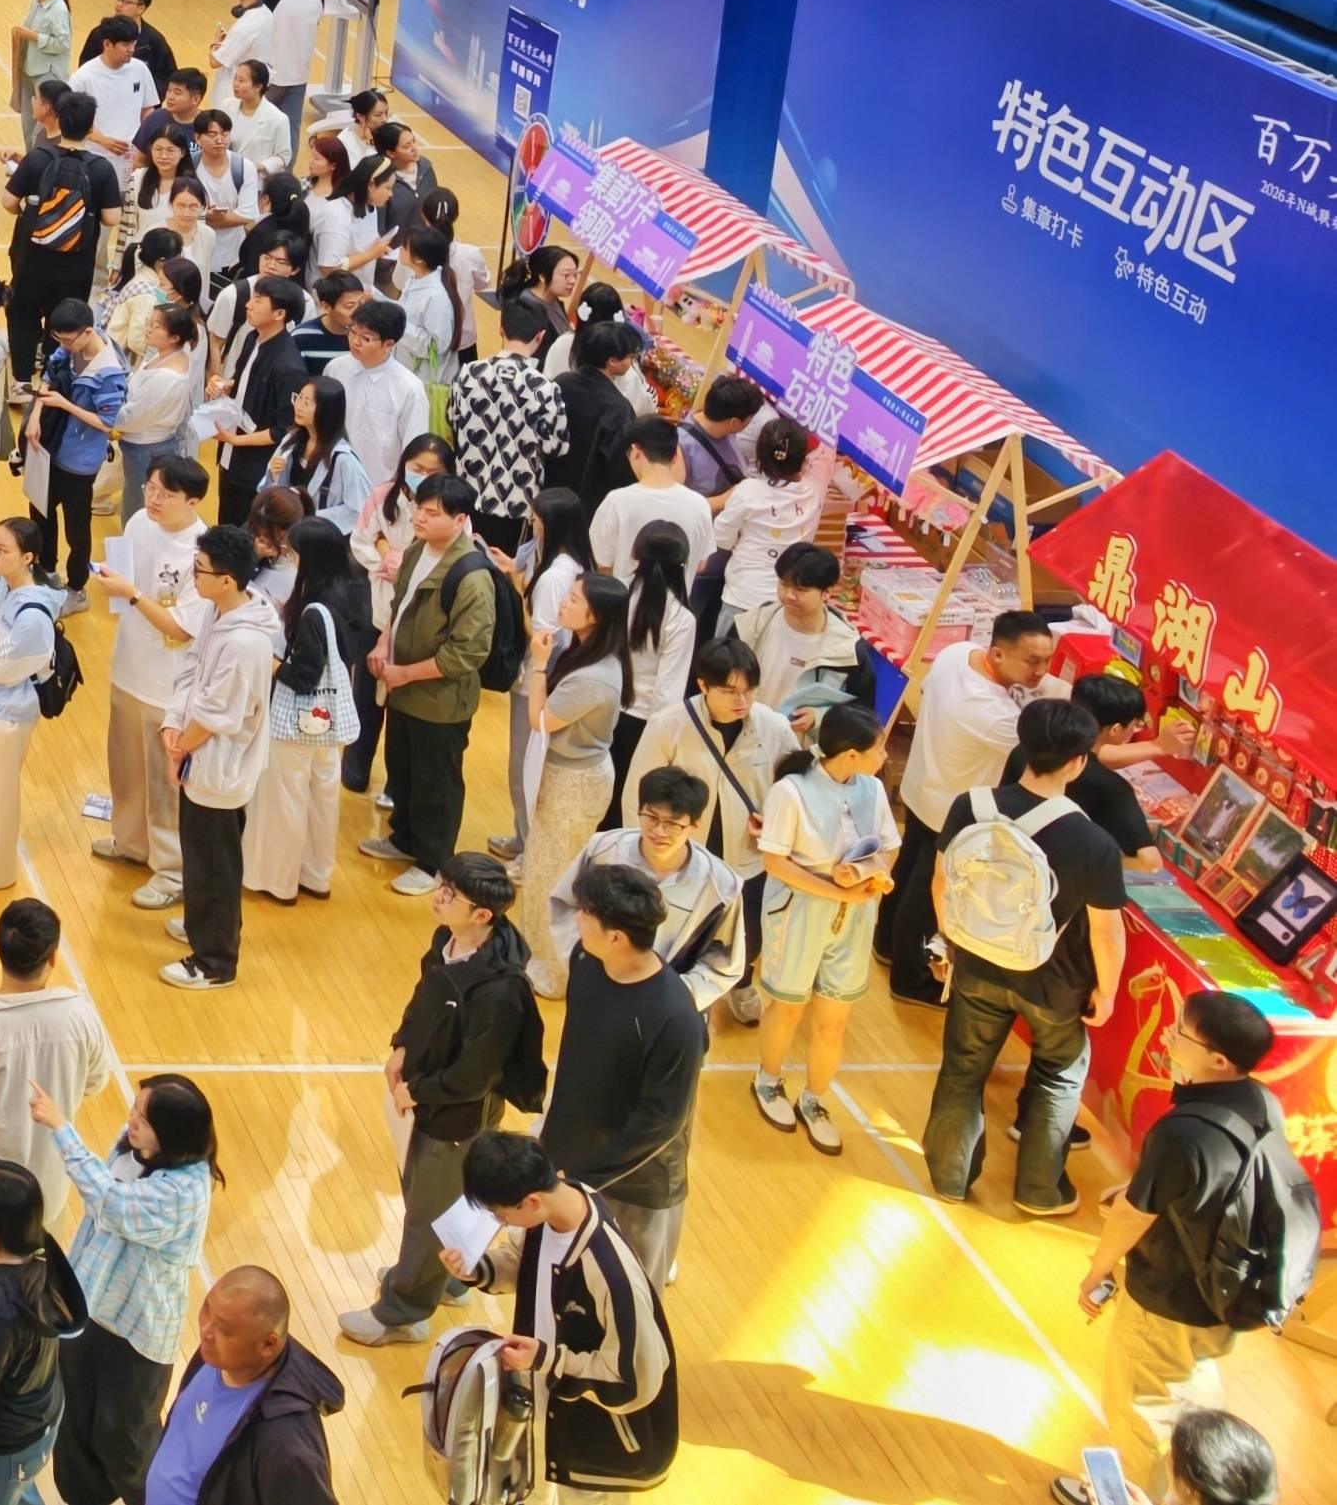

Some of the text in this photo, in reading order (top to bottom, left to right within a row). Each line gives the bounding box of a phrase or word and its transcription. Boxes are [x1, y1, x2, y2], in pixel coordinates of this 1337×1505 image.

[991, 78, 1256, 285] 特色互动区
[1252, 113, 1337, 198] 百万
[584, 161, 660, 228] 集章打卡
[1020, 193, 1085, 250] 集章打卡
[574, 199, 631, 265] 领取点
[1136, 260, 1208, 326] 特色互动
[806, 329, 858, 396] 特色
[775, 367, 850, 447] 互动区
[1088, 531, 1284, 737] 鼎湖山
